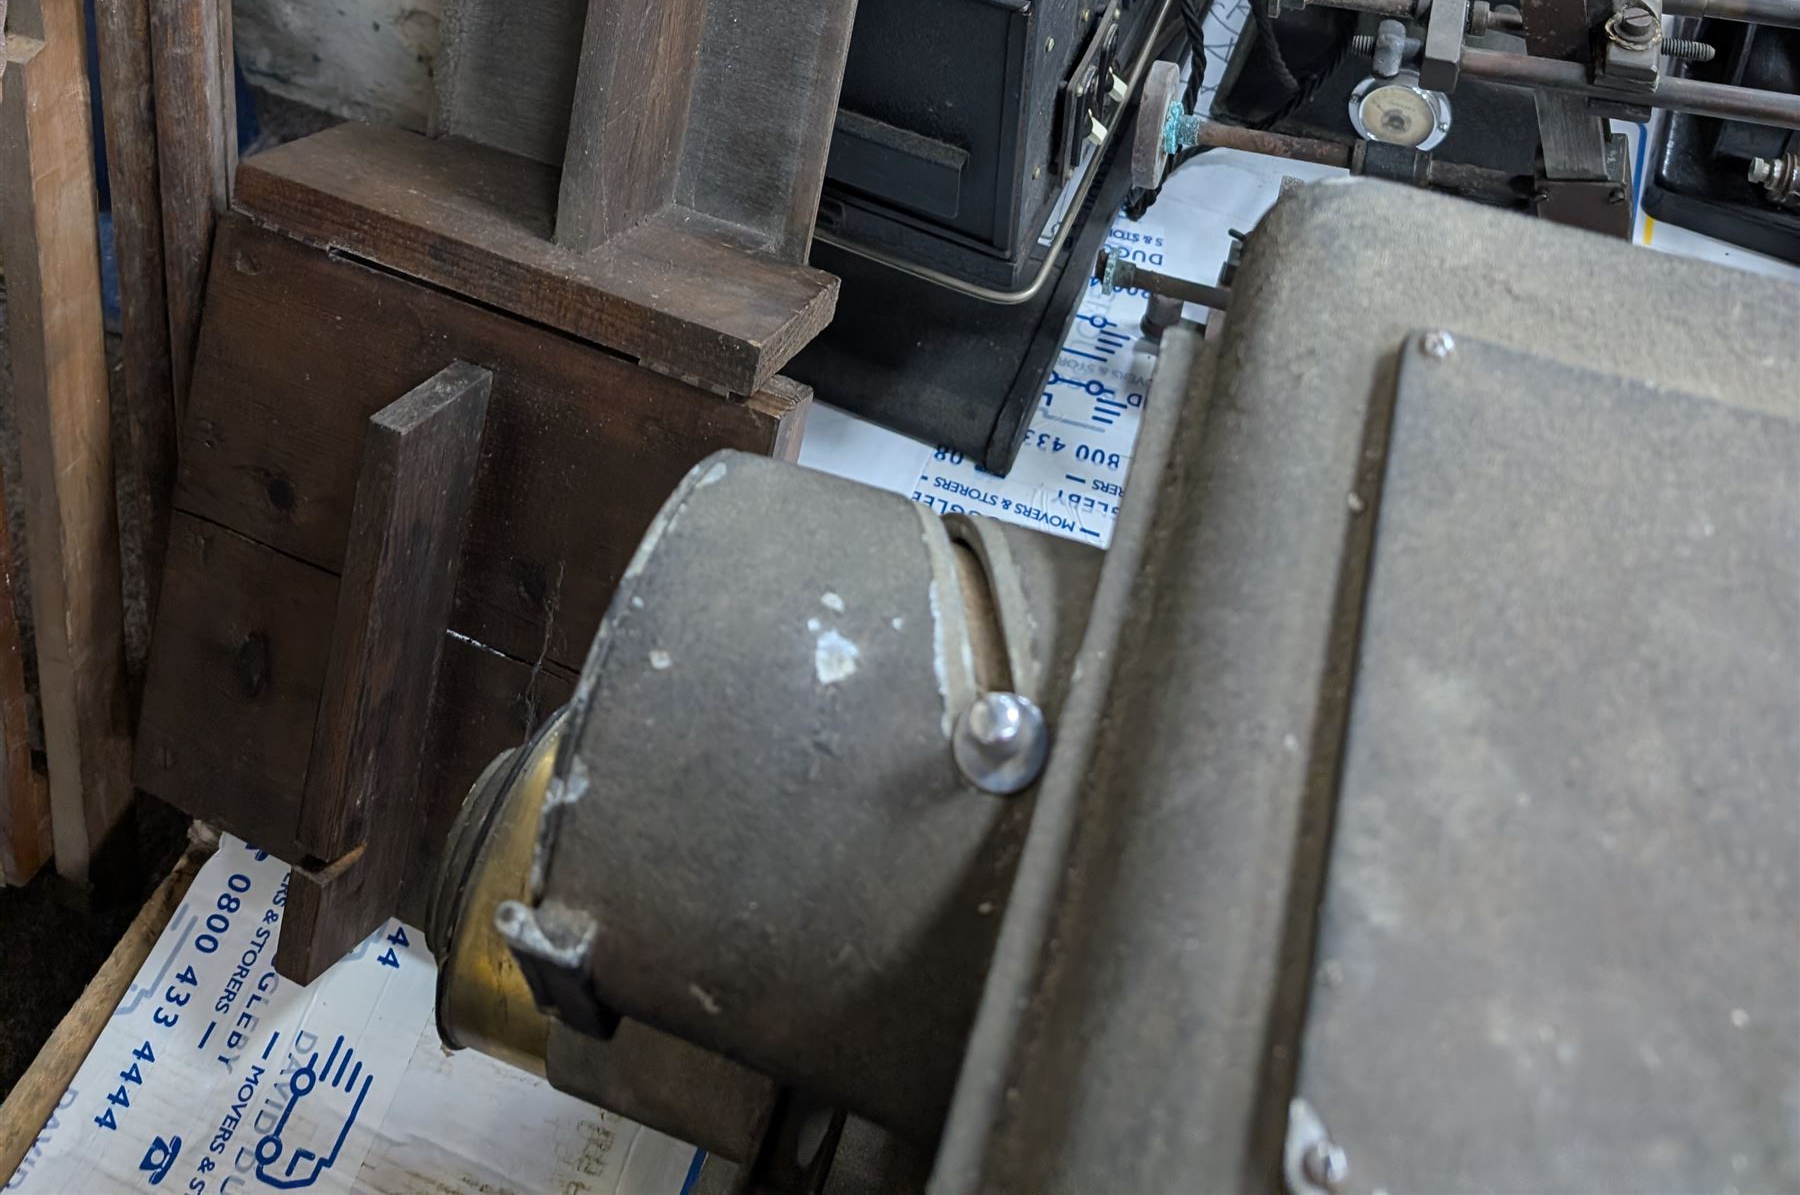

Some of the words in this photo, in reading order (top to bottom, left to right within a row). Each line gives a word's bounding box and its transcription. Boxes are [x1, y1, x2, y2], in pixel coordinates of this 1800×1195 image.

[933, 476, 999, 506] STORERS
[1001, 498, 1012, 510] &
[1014, 504, 1076, 533] MOVERS
[194, 873, 251, 954] 0800
[263, 909, 278, 924] &
[153, 965, 198, 1028] 433
[215, 927, 271, 1014] STORERS
[217, 955, 280, 1075] GLEBY
[94, 1040, 156, 1131] 4444
[209, 1065, 266, 1155] MOVERS
[197, 1156, 215, 1174] &
